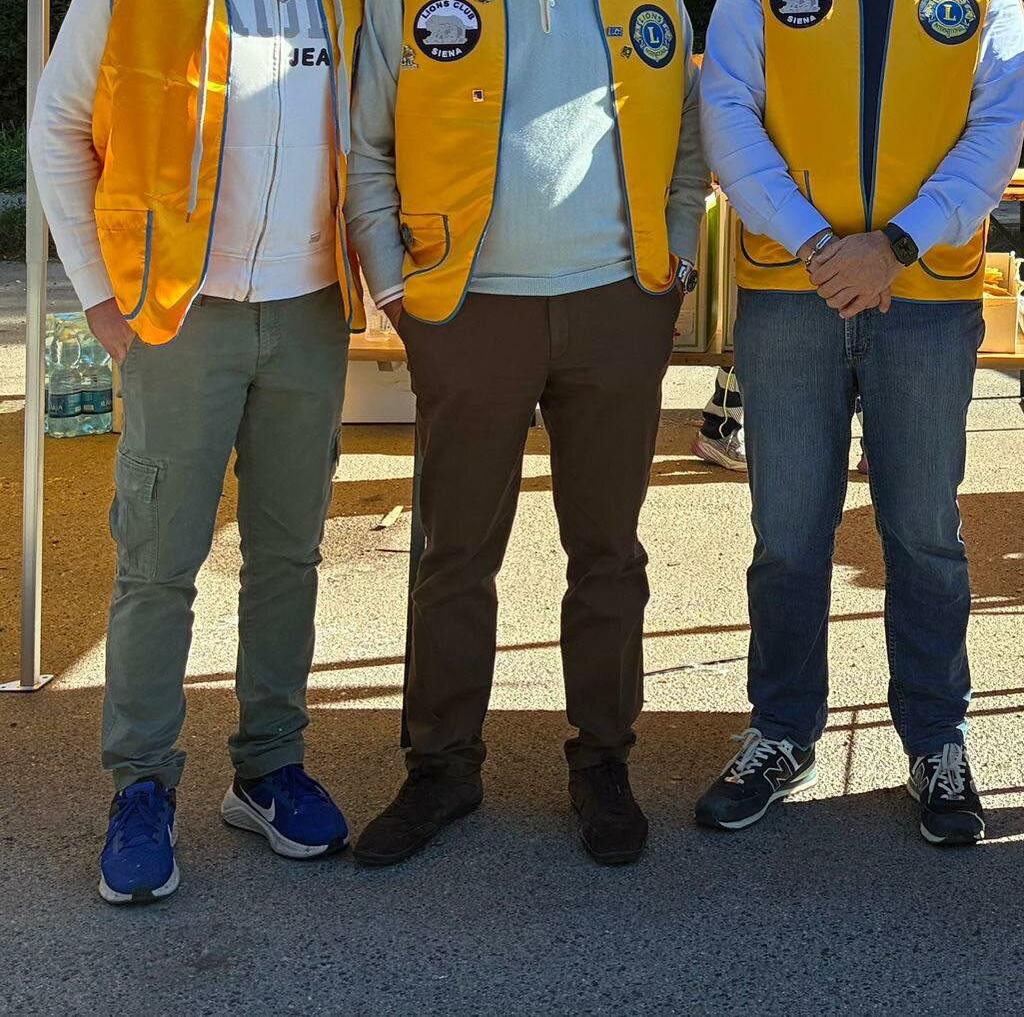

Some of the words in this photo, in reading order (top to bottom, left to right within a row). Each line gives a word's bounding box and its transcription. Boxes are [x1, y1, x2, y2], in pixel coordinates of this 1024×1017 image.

[421, 0, 450, 19] LIONS
[453, 1, 475, 20] CLUB
[943, 4, 957, 21] L
[639, 12, 663, 23] LIONS
[786, 15, 817, 25] SIENA
[647, 26, 660, 44] L
[431, 47, 463, 58] SIENA
